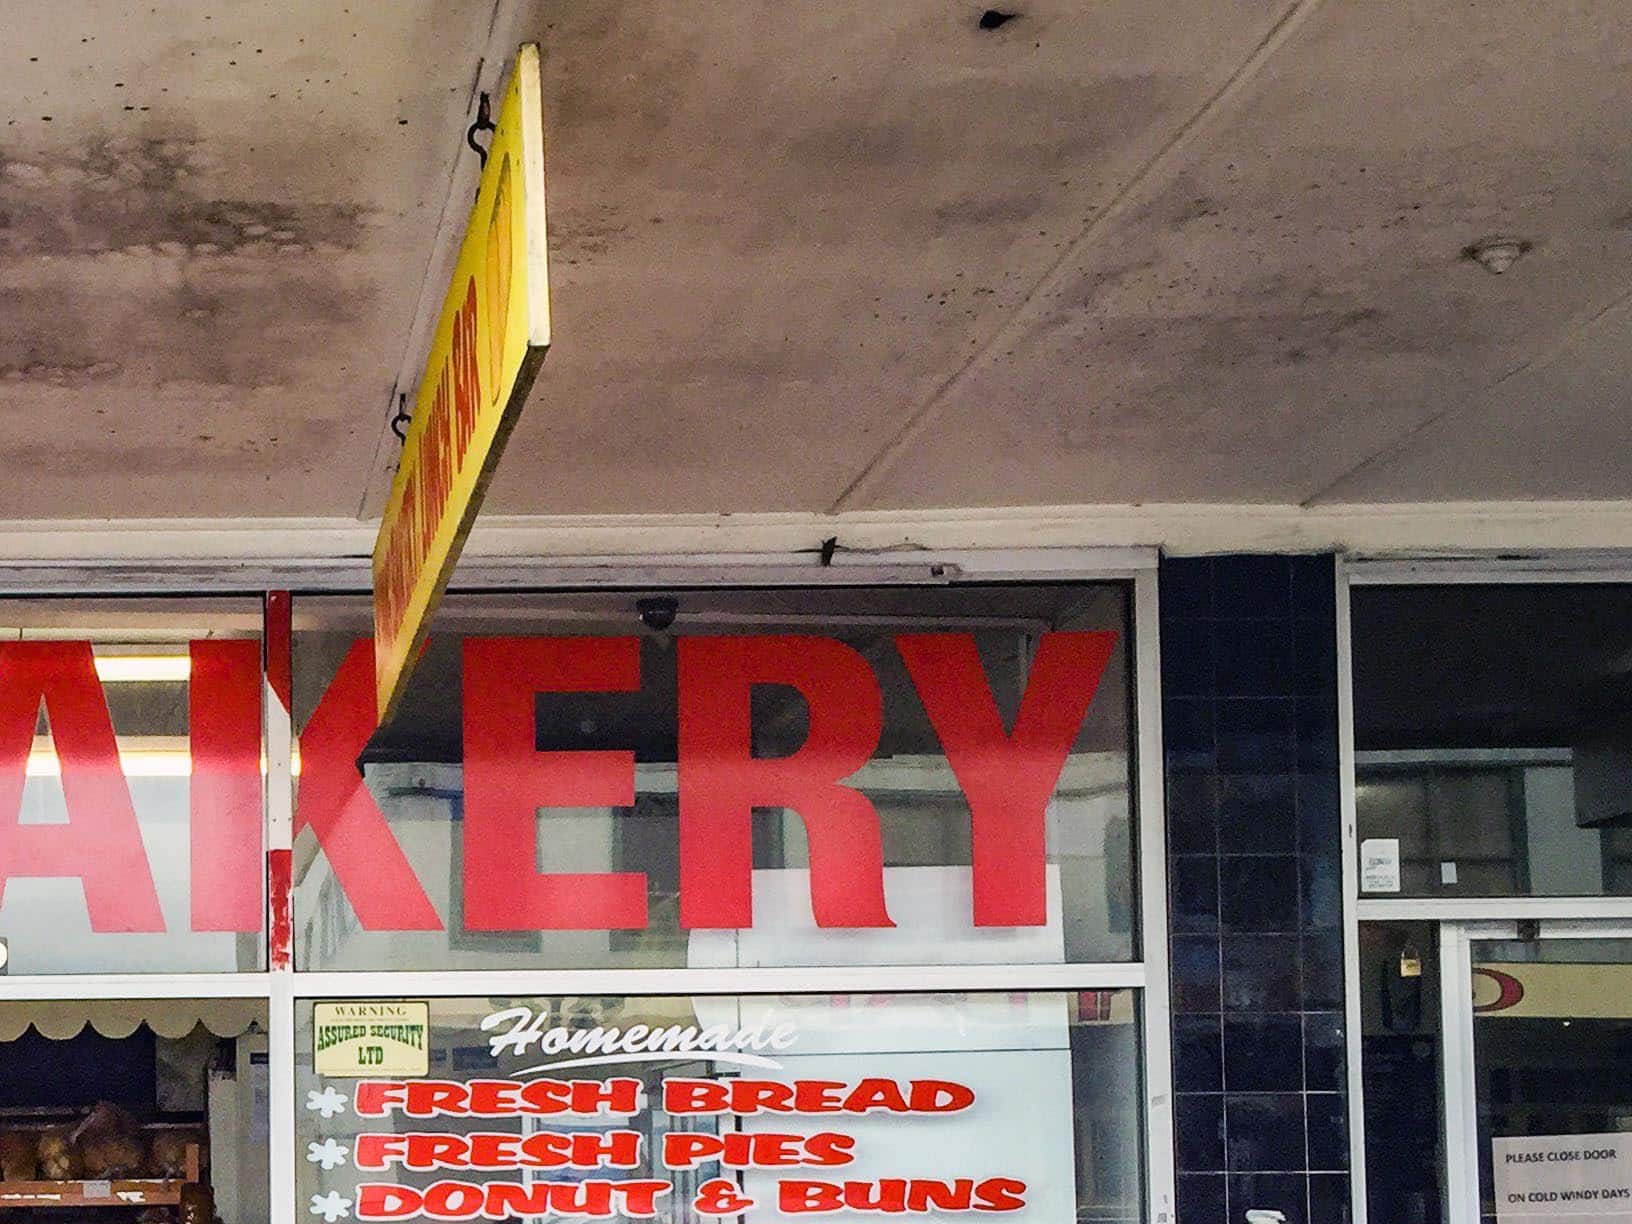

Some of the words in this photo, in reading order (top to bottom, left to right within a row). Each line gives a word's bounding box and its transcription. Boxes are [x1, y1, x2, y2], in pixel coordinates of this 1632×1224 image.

[452, 274, 481, 475] BAR
[335, 1006, 408, 1017] WARNING
[317, 1024, 367, 1052] ASSURED
[370, 1024, 424, 1051] SECURITY
[480, 1006, 801, 1058] Homemade
[358, 1046, 384, 1065] LTD
[354, 1078, 643, 1118] FRESH
[661, 1077, 977, 1117] BREAD
[354, 1131, 643, 1170] FRESH
[661, 1131, 856, 1168] PIES
[1505, 1152, 1545, 1164] PLEASE
[1547, 1151, 1581, 1162] CLOSE
[1583, 1149, 1617, 1160] DOOR
[356, 1180, 671, 1220] DONUT
[693, 1179, 755, 1216] &
[777, 1178, 1028, 1216] BUNS
[1508, 1193, 1525, 1203] ON
[1528, 1192, 1558, 1202] COLD
[1560, 1189, 1599, 1201] WINDY
[1602, 1188, 1631, 1199] DAYS
